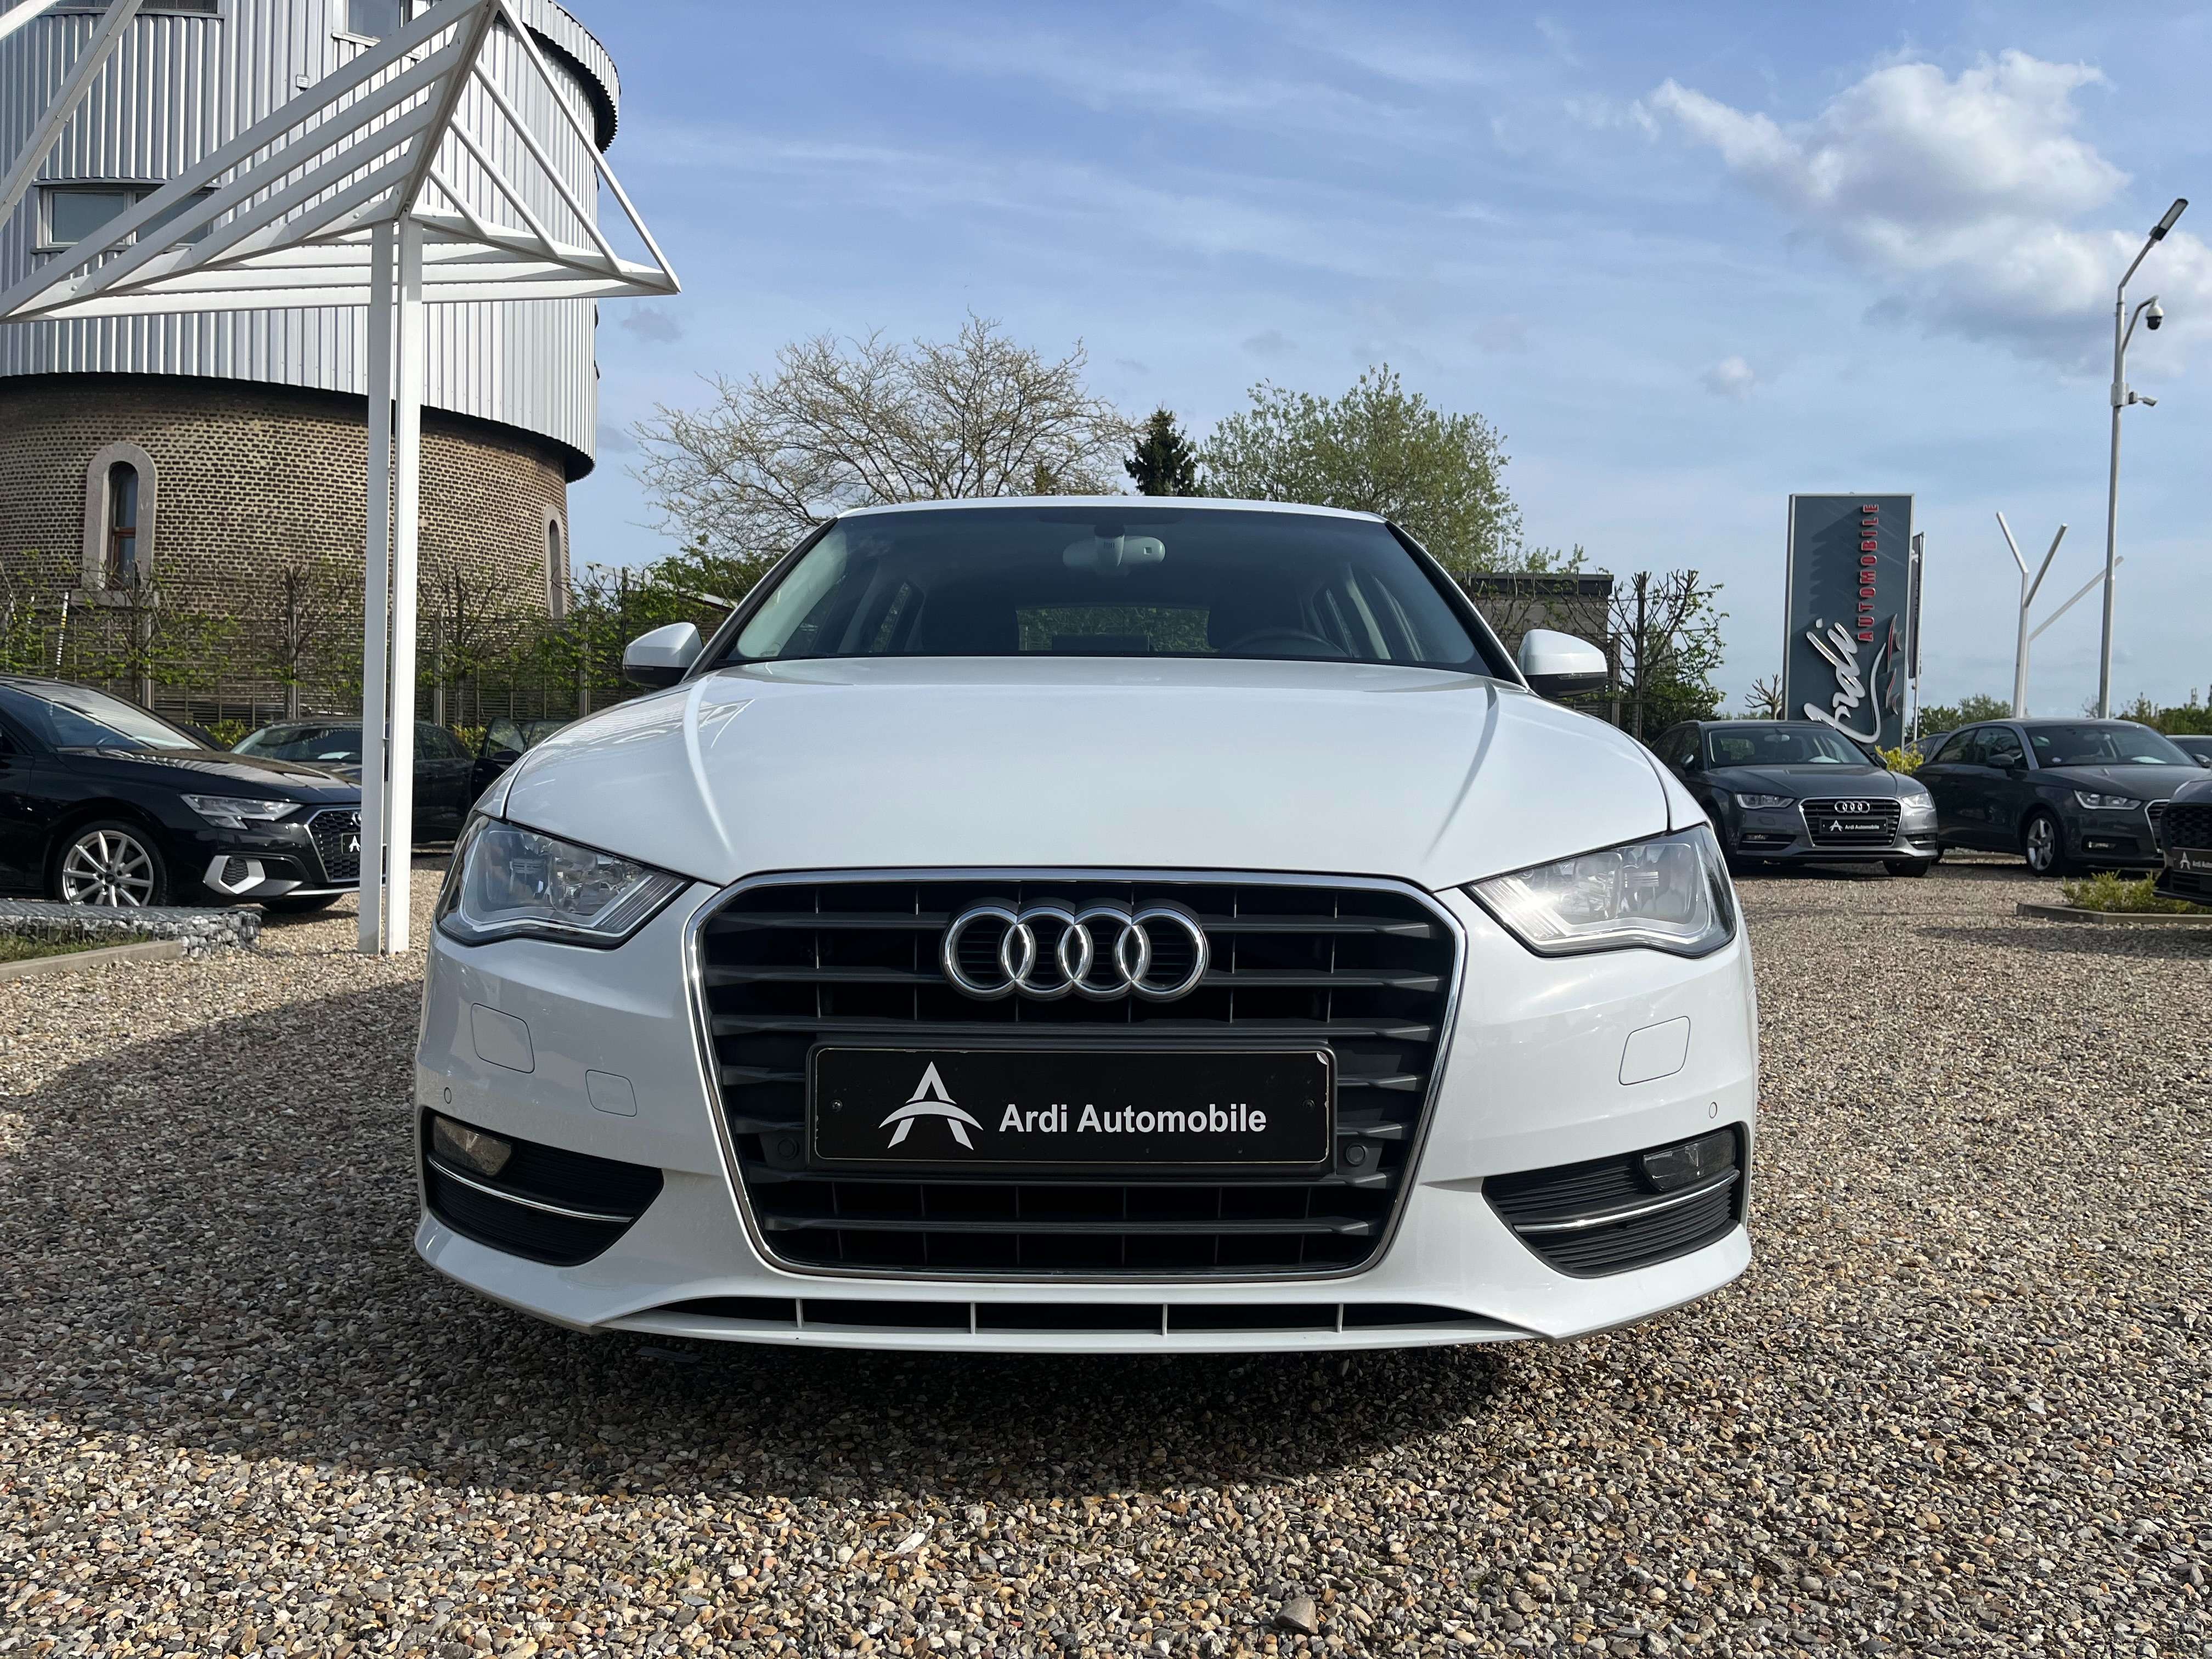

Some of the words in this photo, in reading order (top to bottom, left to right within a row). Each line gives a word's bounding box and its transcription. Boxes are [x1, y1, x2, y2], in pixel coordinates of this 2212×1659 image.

[1858, 504, 1879, 642] AUTOMOBILE
[999, 1104, 1067, 1132] Ardi
[1076, 1103, 1266, 1133] Automobile
